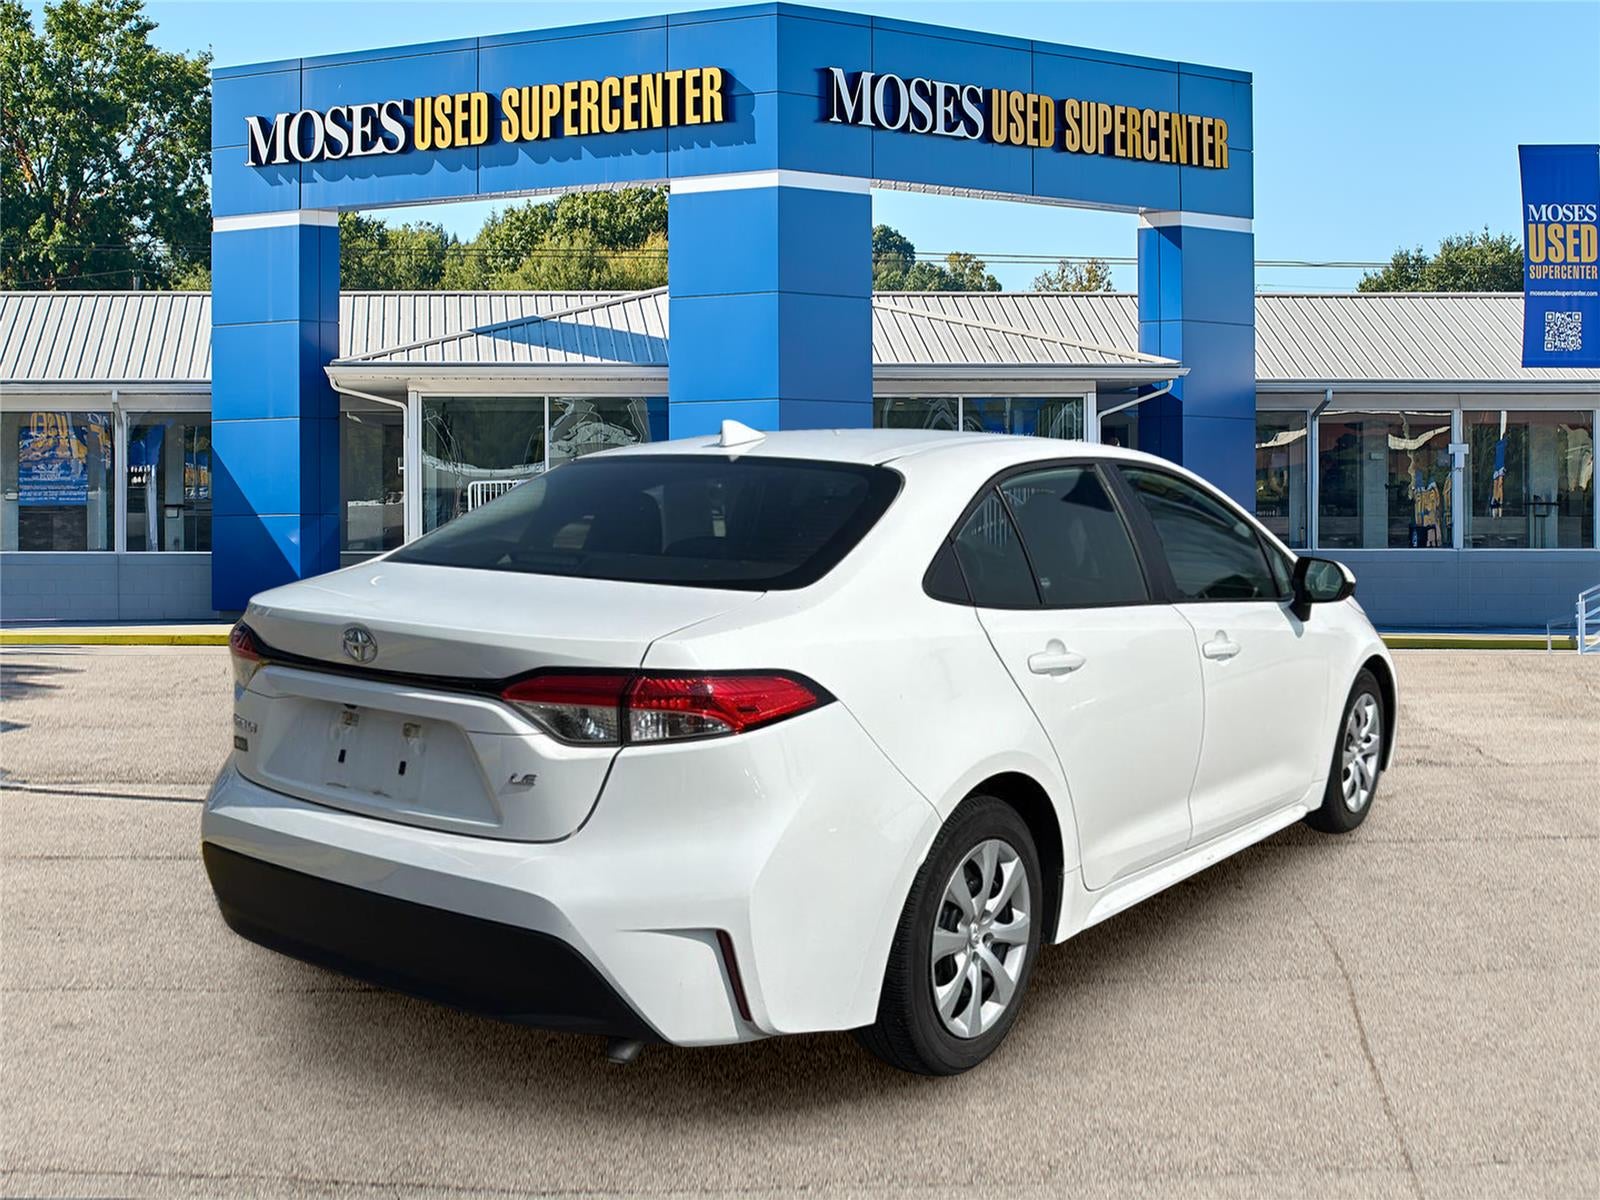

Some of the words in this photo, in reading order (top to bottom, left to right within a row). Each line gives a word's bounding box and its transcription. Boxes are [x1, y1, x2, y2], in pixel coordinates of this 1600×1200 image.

[244, 100, 406, 167] MOSES
[414, 91, 489, 151] USED
[501, 66, 724, 143] SUPERCENTER
[829, 66, 985, 140] MOSES
[991, 88, 1056, 148] USED
[1065, 98, 1230, 169] SUPERCENTER
[1528, 203, 1597, 222] MOSES
[1528, 223, 1598, 263] USED
[1529, 264, 1598, 280] SUPERCENTER
[509, 773, 537, 786] LE
